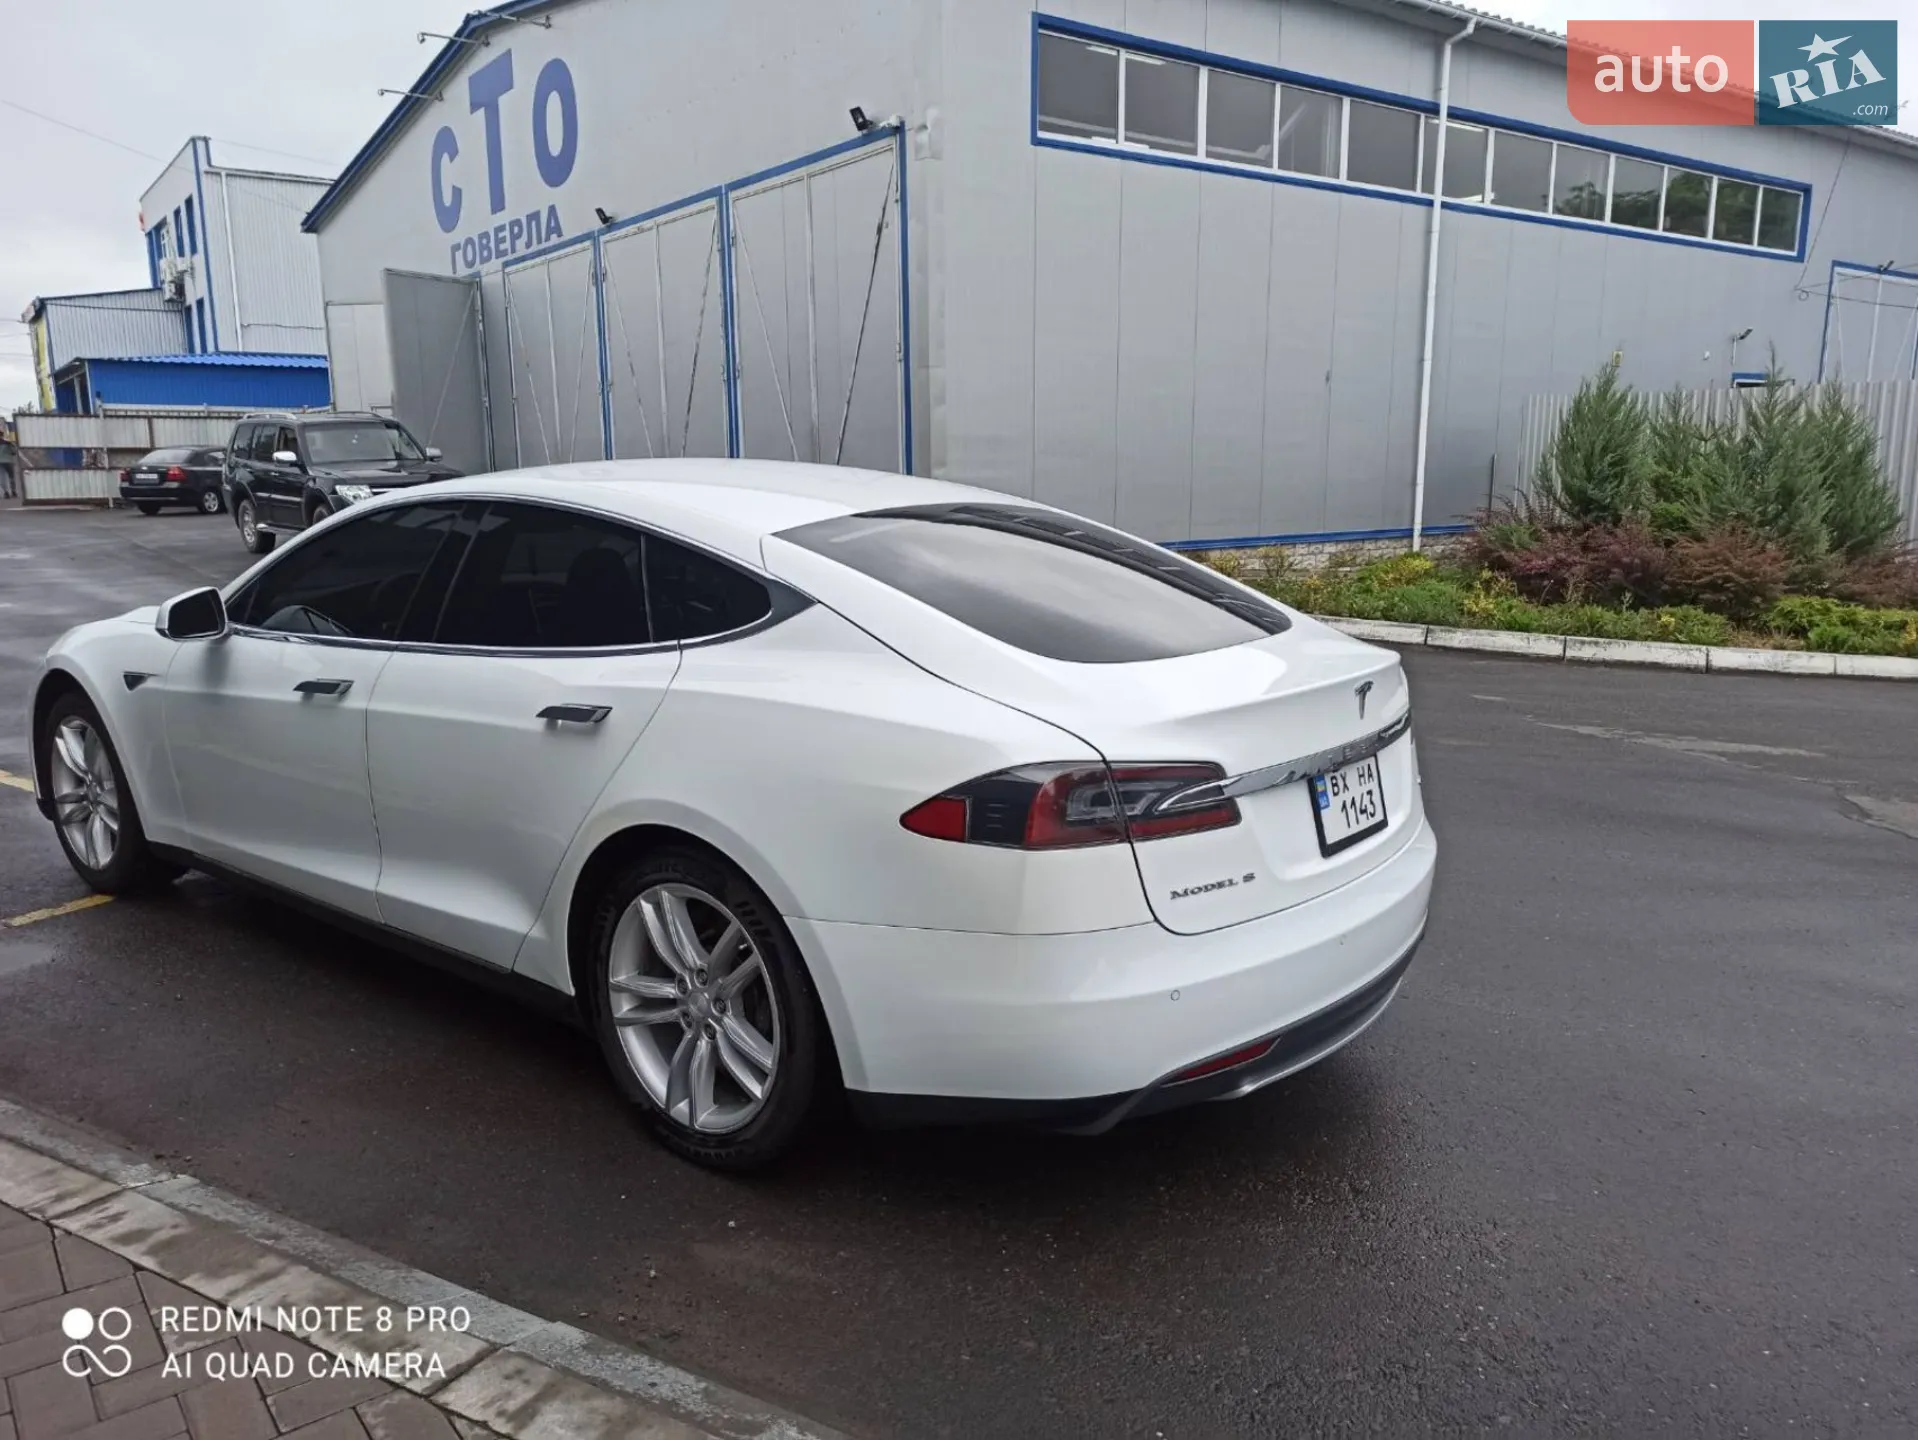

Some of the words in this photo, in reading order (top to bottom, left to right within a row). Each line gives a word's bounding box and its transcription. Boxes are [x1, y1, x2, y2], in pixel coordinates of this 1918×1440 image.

[431, 48, 579, 233] СТО
[450, 204, 564, 275] ГОВЕРЛА
[1356, 763, 1375, 787] HA
[1341, 789, 1377, 829] 1143
[1169, 878, 1239, 900] MODEL
[1242, 872, 1256, 883] S
